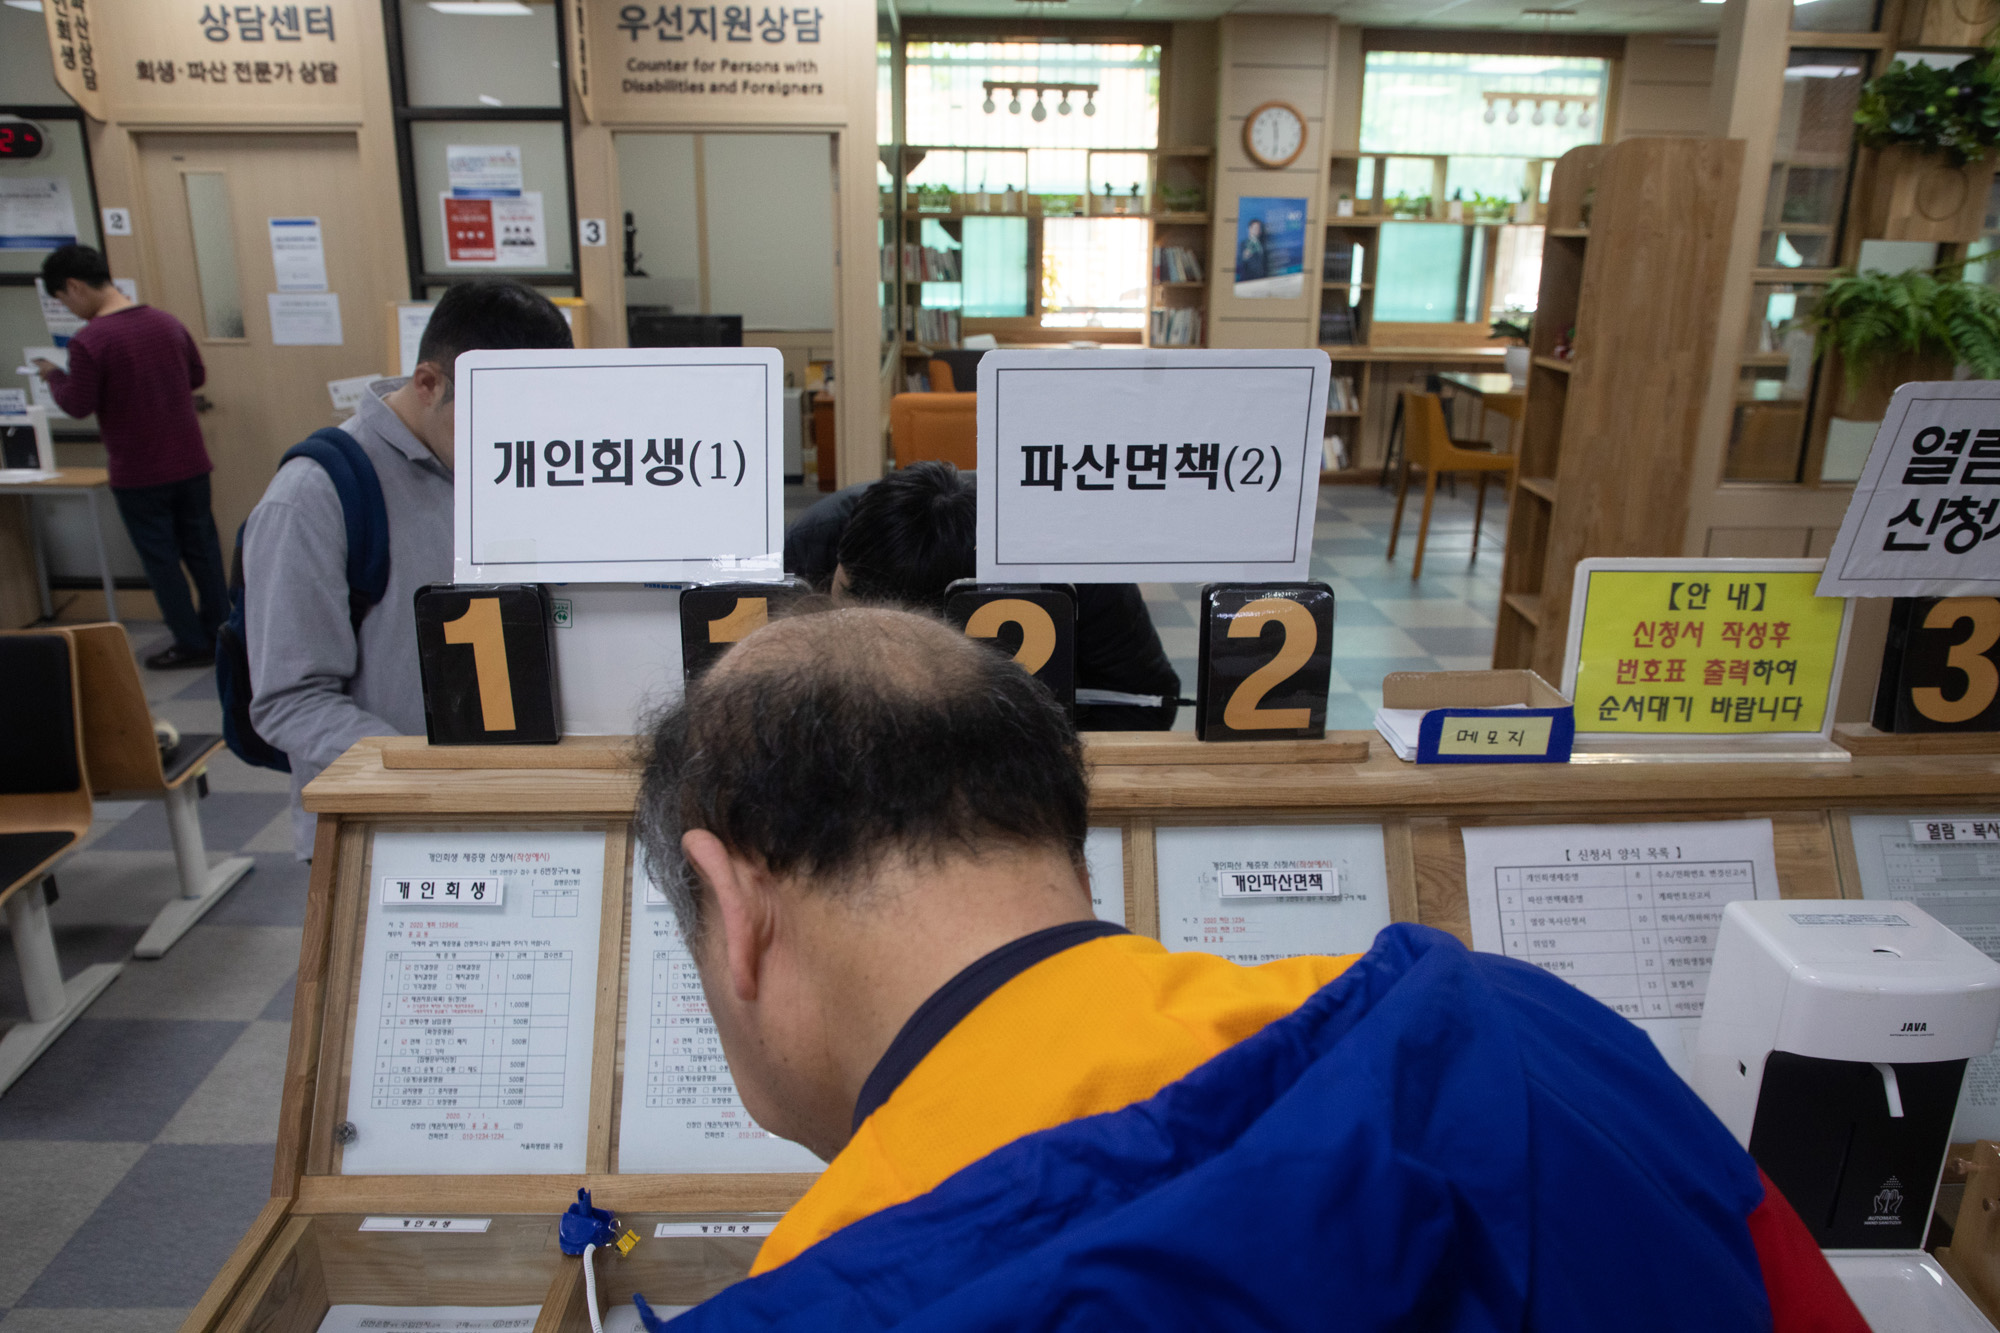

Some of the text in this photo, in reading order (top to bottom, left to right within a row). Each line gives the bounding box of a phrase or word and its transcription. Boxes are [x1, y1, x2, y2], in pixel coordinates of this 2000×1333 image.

[199, 4, 337, 43] 상담센터
[617, 4, 824, 43] 우선지원상담
[233, 60, 294, 84] 전문가
[299, 60, 339, 84] 상담
[627, 57, 818, 74] Counter for Persons with
[622, 78, 823, 97] Disabilities and Foreigners
[110, 212, 124, 230] 2
[586, 221, 601, 244] 3
[494, 437, 746, 489] 개인회생(1)
[1020, 443, 1283, 492] 파산면책(2)
[1882, 495, 2000, 555] 신청
[1633, 620, 1791, 648] 신청서 작성후
[443, 597, 517, 732] 1
[1223, 598, 1318, 731] 2
[1616, 658, 1797, 686] 번호표 출력하여
[1911, 597, 2000, 723] 3
[1598, 696, 1804, 722] 순서대기 바랍니다
[1578, 847, 1611, 861] 신청서
[1617, 846, 1641, 861] 양식
[1646, 845, 1671, 860] 목록
[1231, 873, 1323, 893] 개인파산면책
[1900, 1022, 1927, 1032] JAVA
